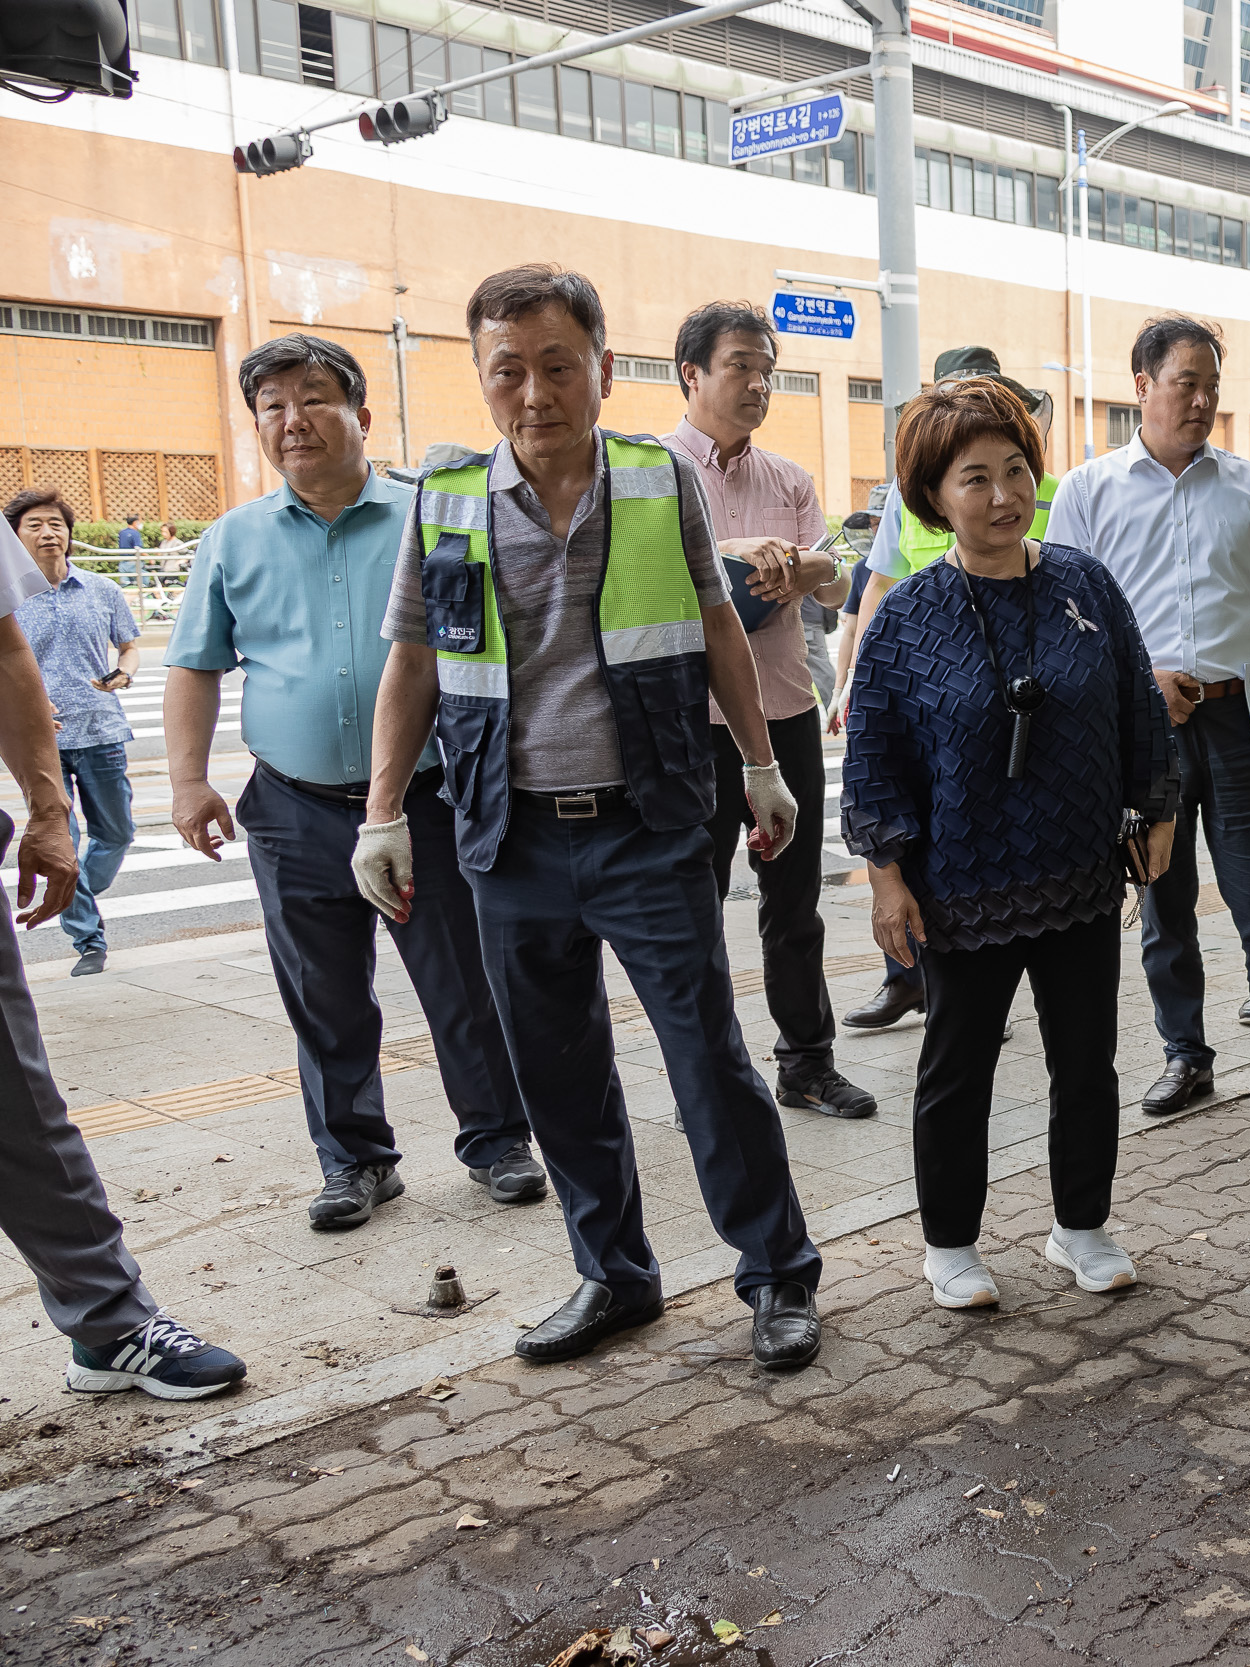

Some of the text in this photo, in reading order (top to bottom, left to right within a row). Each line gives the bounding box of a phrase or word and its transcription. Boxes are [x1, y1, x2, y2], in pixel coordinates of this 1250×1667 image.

[734, 104, 811, 144] 강변역로4길
[733, 124, 829, 157] Gangbyeonnyeok-ro 4-gil
[795, 298, 836, 314] 강변역로
[449, 627, 475, 635] 광진구
